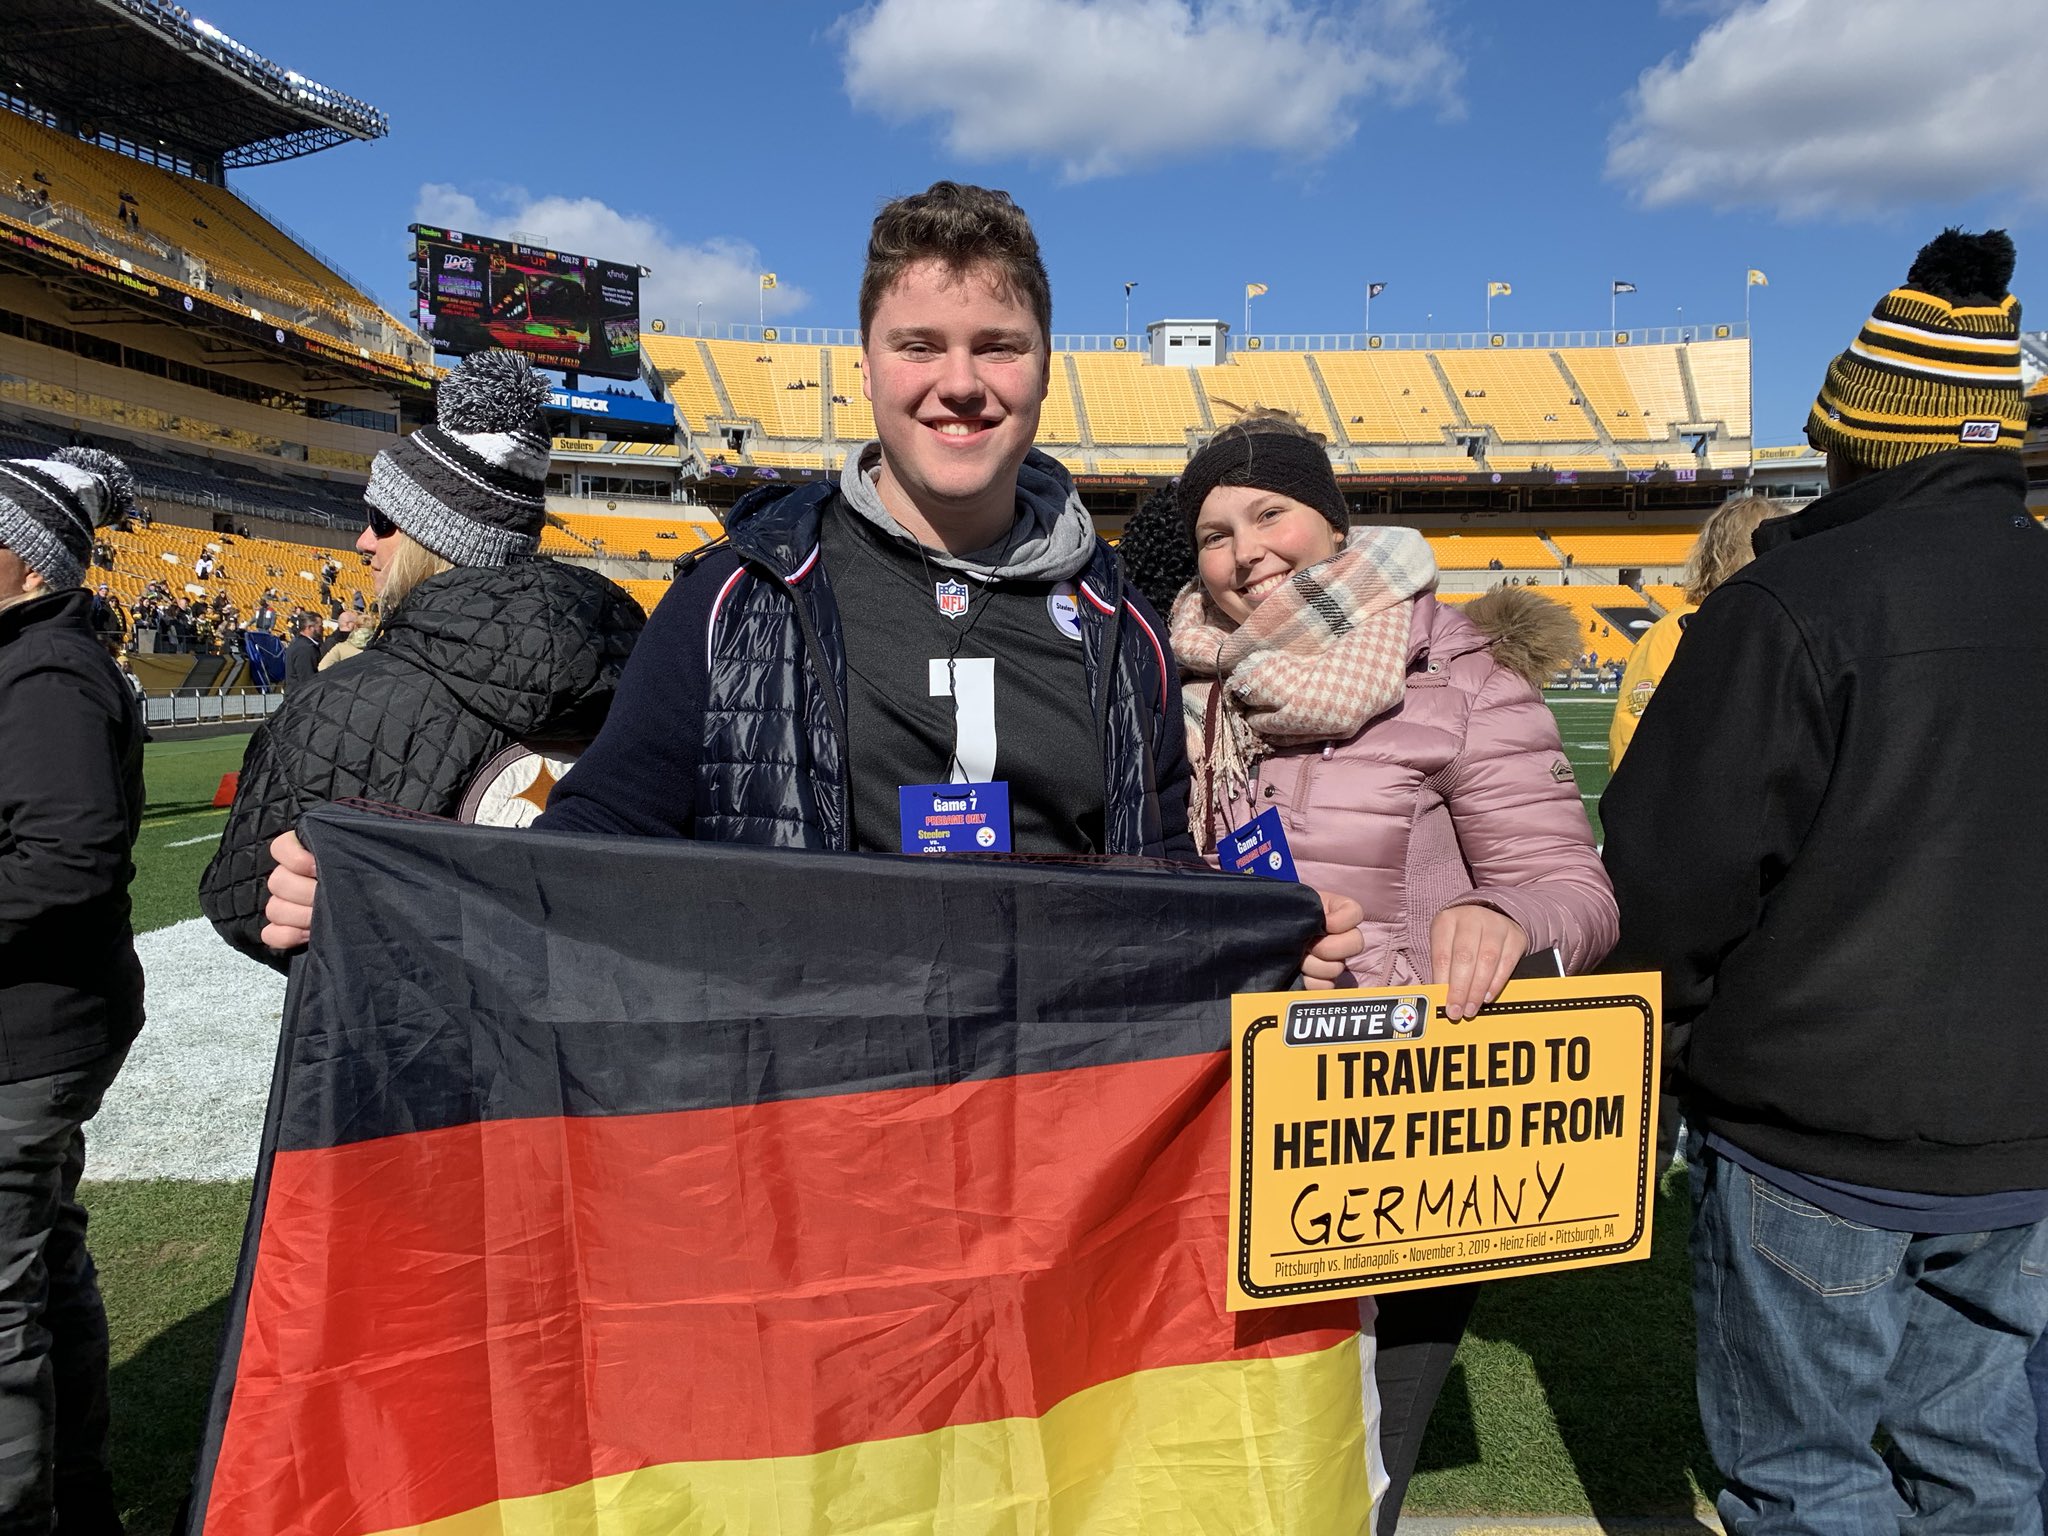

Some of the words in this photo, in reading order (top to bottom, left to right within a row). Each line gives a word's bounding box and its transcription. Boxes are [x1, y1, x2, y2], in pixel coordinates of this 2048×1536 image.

[561, 254, 580, 266] COLTS
[606, 269, 629, 281] xfinity
[118, 273, 159, 297] Pittsburgh
[537, 353, 559, 364] HEINZ
[560, 357, 580, 368] FIELD
[571, 395, 609, 413] DECK
[560, 439, 594, 451] Steelers
[1760, 448, 1796, 459] Steelers
[1111, 477, 1148, 485] Pittsburgh
[1429, 475, 1468, 484] Pittsburgh
[940, 595, 964, 612] NFL
[1056, 602, 1075, 613] Steelers
[933, 798, 967, 812] Game
[969, 797, 978, 811] 7
[925, 814, 965, 826] PREGAME
[965, 813, 987, 825] ONLY
[918, 829, 951, 840] Steelers
[923, 845, 947, 853] COLTS
[1237, 835, 1258, 855] Game
[1257, 829, 1263, 841] 7
[1296, 1006, 1348, 1017] STEELERS
[1350, 1004, 1388, 1014] NATION
[1293, 1013, 1386, 1039] UNITE
[1317, 1054, 1327, 1101] I
[1338, 1041, 1537, 1099] TRAVELED
[1544, 1036, 1591, 1083] TO
[1273, 1115, 1396, 1171] HEINZ
[1406, 1105, 1511, 1159] FIELD
[1520, 1094, 1625, 1148] FROM
[1290, 1160, 1565, 1246] GERMANY
[1275, 1258, 1326, 1278] Pittsburgh
[1328, 1260, 1341, 1272] vs.
[1343, 1249, 1399, 1270] Indianapolis
[1409, 1243, 1455, 1262] November
[1457, 1242, 1467, 1258] 3,
[1468, 1238, 1490, 1256] 2019
[1500, 1235, 1524, 1251] Heinz
[1526, 1231, 1546, 1248] Field
[1555, 1225, 1602, 1244] Pittsburgh,
[1604, 1223, 1615, 1238] PA
